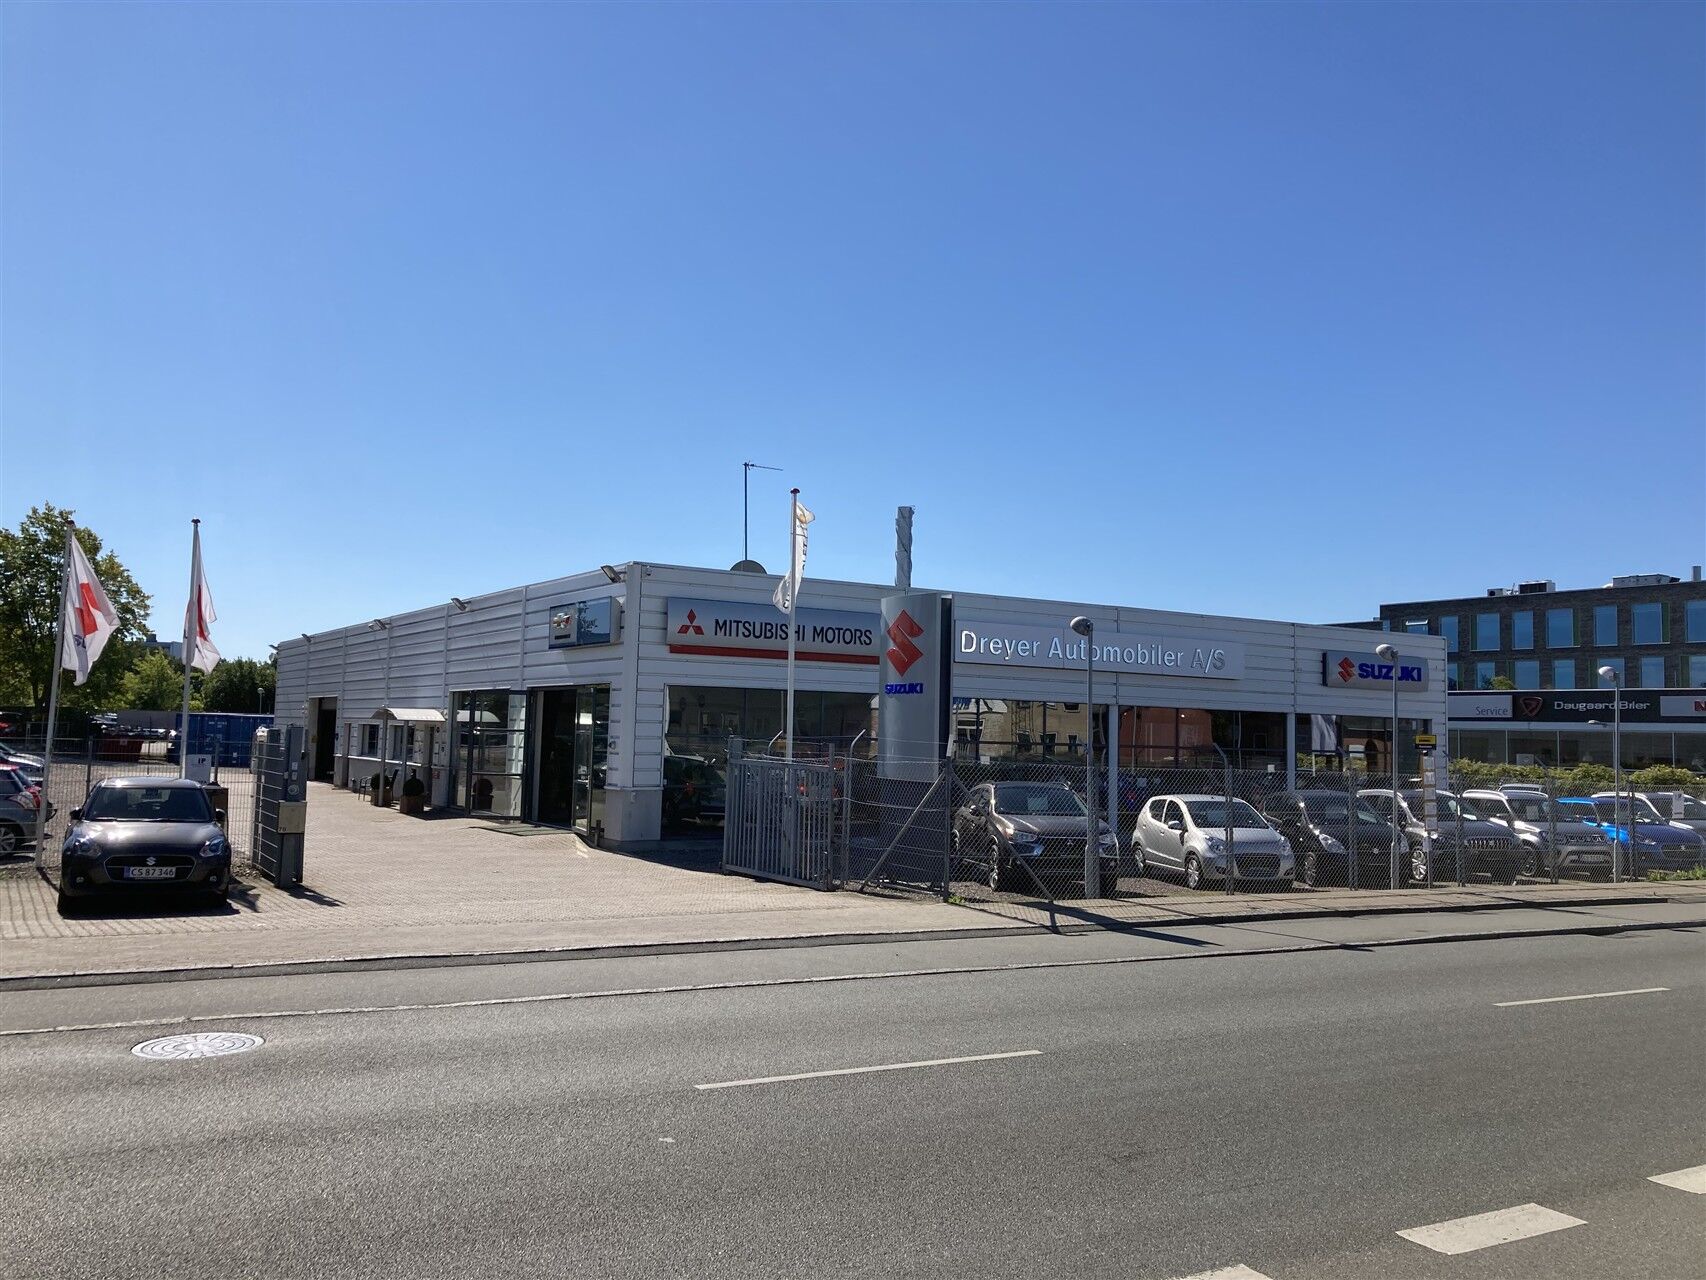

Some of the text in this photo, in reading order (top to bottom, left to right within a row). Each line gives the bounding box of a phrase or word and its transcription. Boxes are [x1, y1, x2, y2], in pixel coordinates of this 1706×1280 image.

[714, 618, 873, 646] MITSUBISHI MOTORS
[961, 630, 1226, 674] Dreyer Automobiler A/S
[1358, 662, 1422, 682] SUZUKI
[885, 682, 924, 695] SUZUKI
[1475, 706, 1509, 716] Service
[1554, 701, 1616, 711] Daugaard
[131, 868, 143, 876] CS
[145, 868, 156, 876] 87
